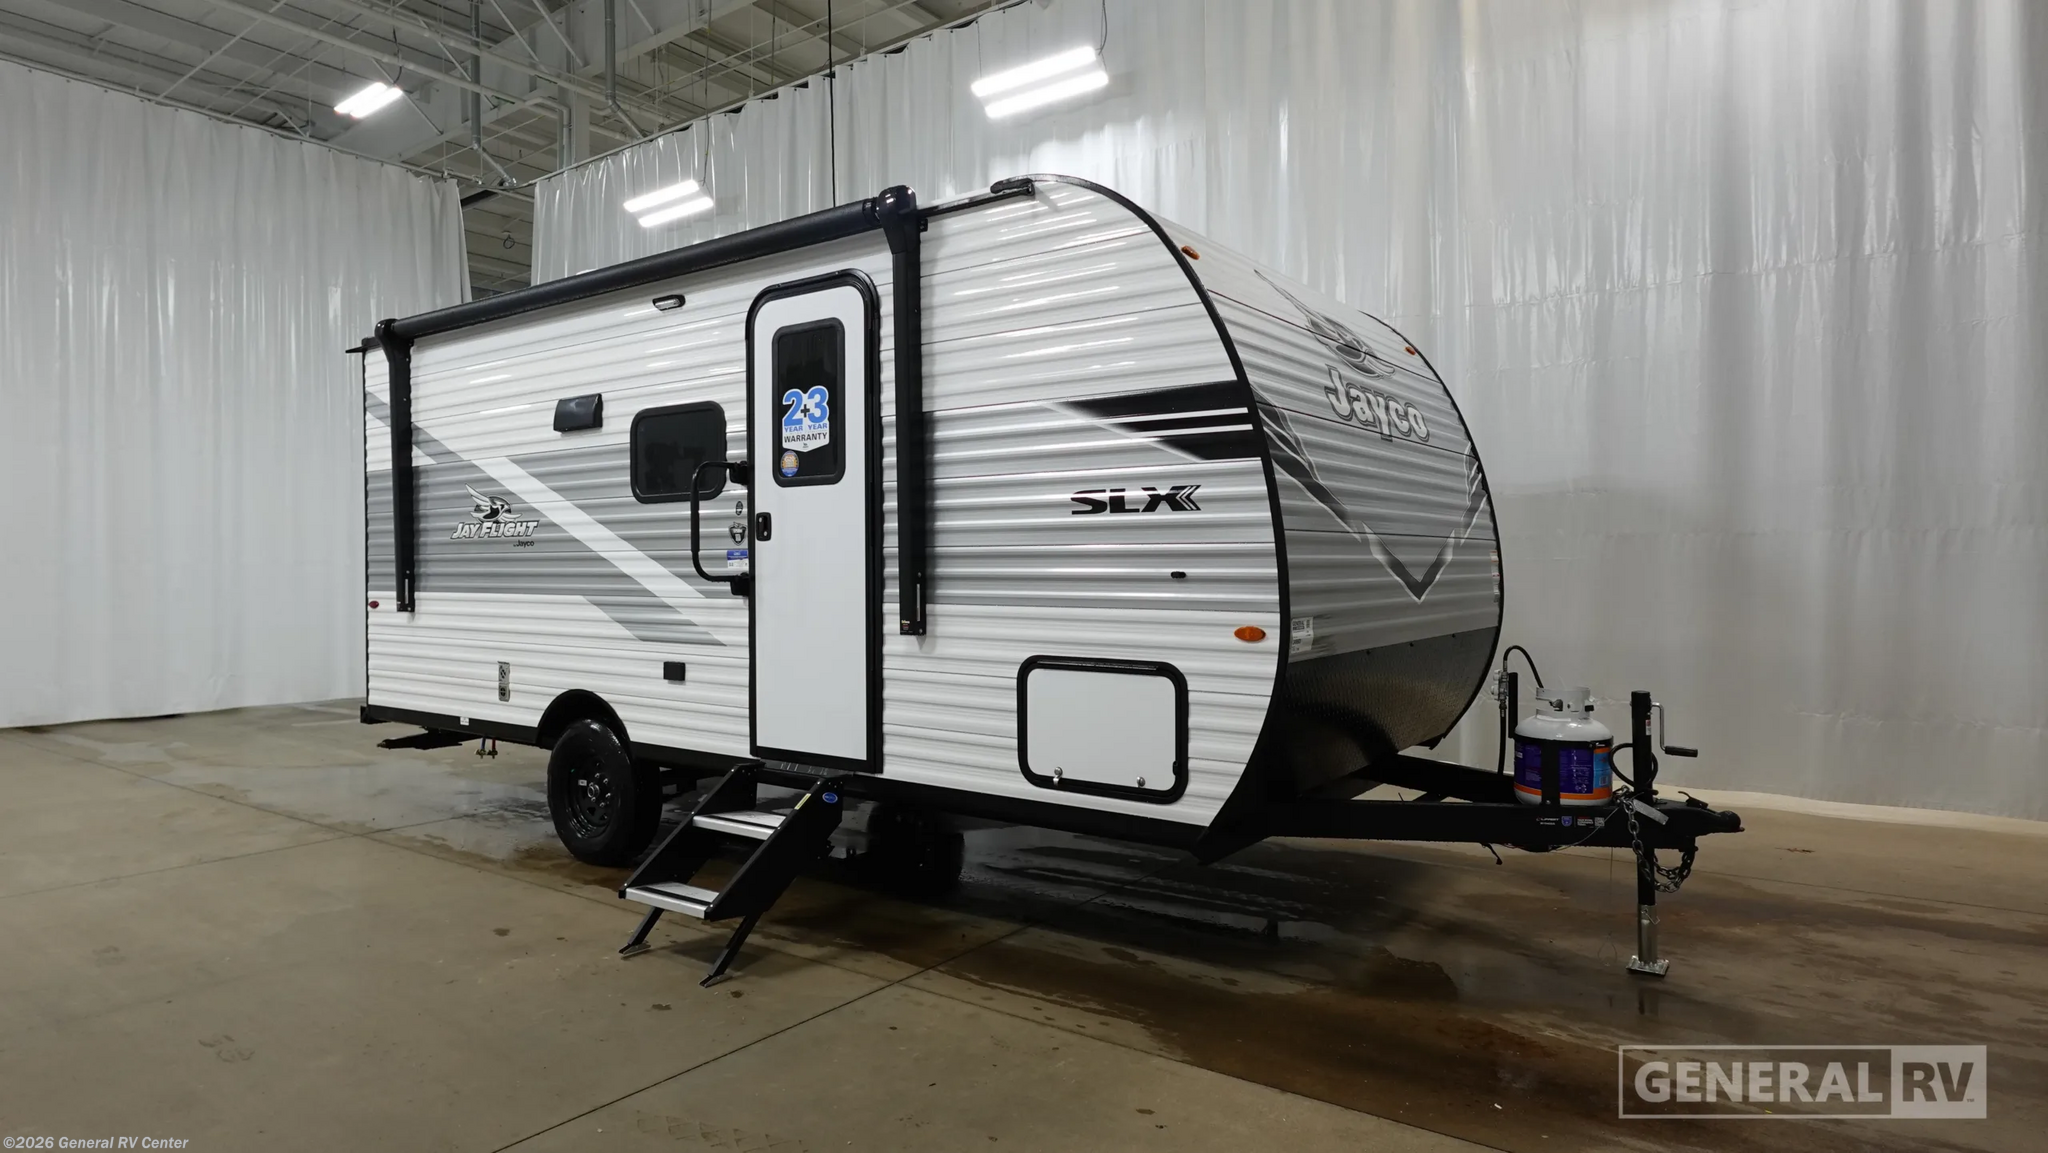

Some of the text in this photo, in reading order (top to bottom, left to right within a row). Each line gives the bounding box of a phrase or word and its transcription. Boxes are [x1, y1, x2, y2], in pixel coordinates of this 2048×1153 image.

[1324, 364, 1430, 443] Jayco
[784, 425, 803, 433] YEAR
[807, 423, 828, 431] YEAR
[784, 432, 828, 443] WARRANTY
[1071, 484, 1202, 515] SLX
[451, 520, 540, 539] JAY FLIGHT
[516, 540, 535, 548] Jayco
